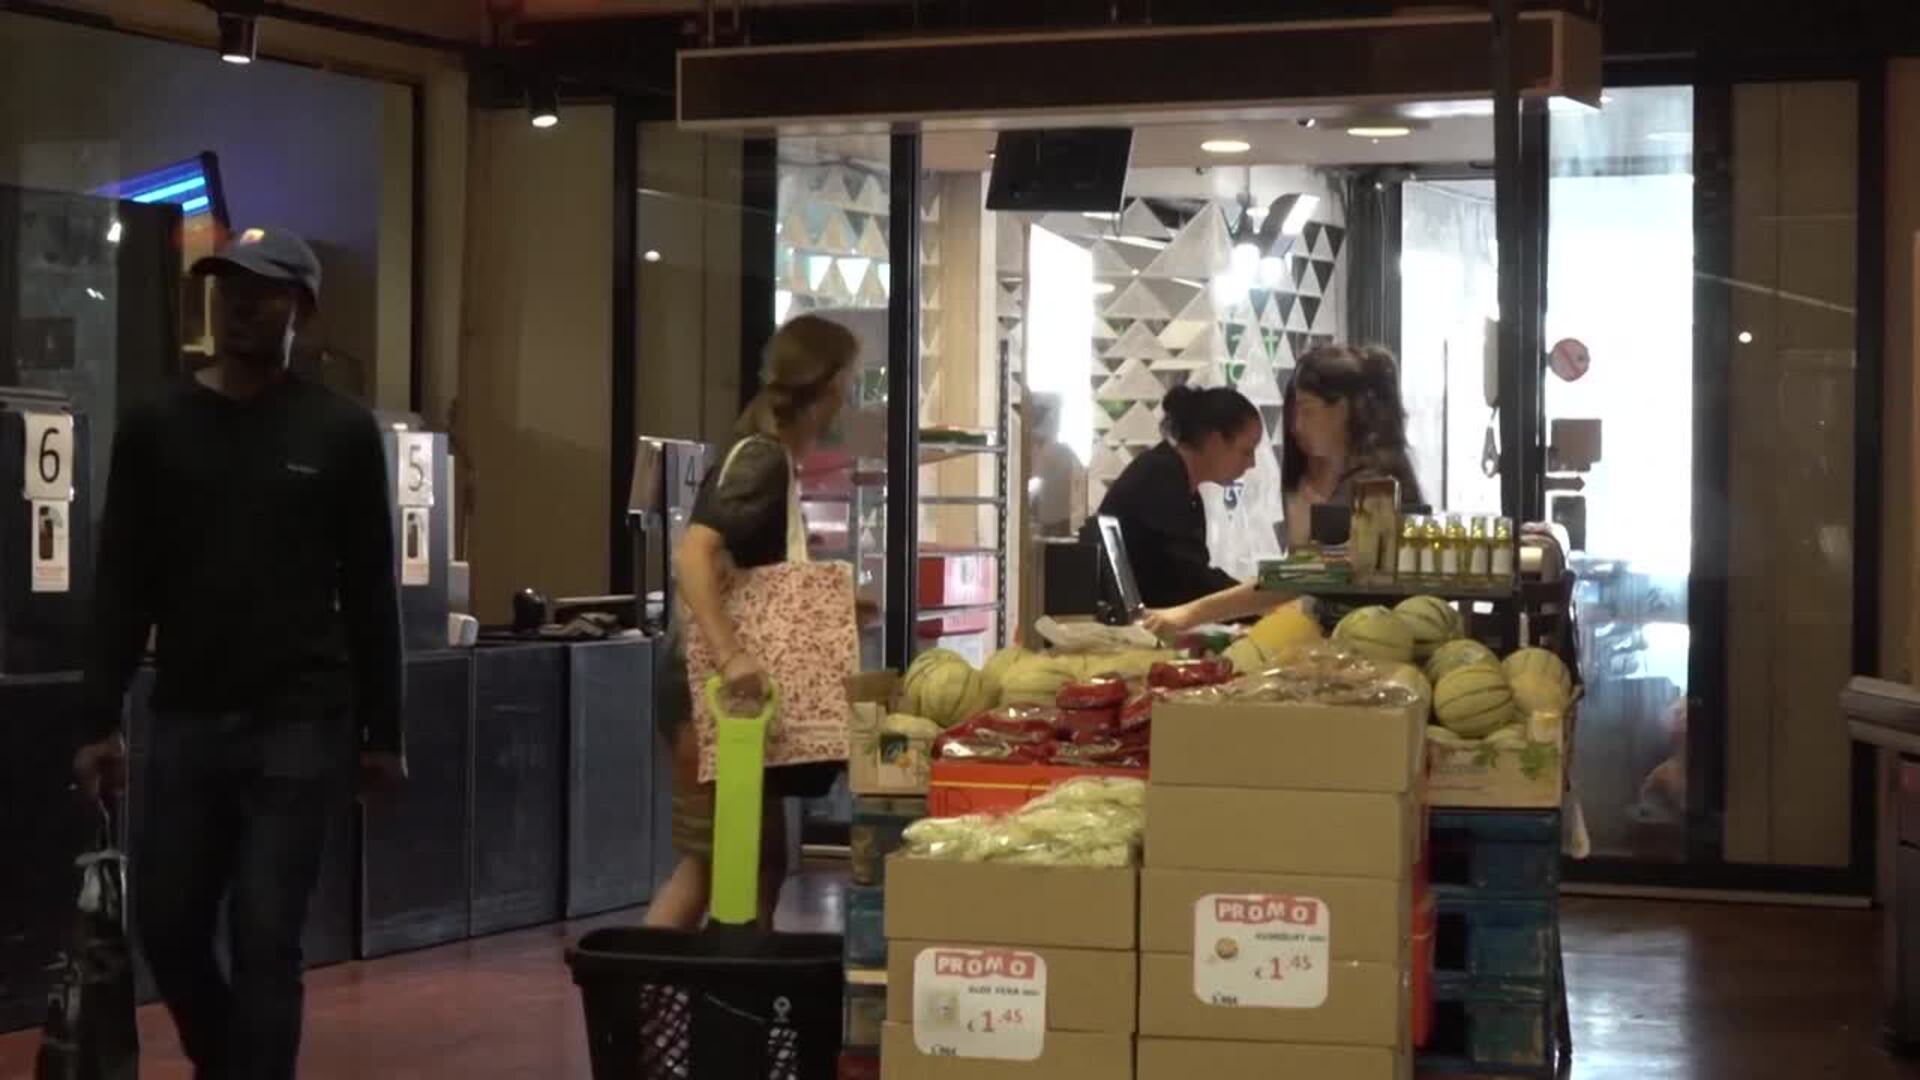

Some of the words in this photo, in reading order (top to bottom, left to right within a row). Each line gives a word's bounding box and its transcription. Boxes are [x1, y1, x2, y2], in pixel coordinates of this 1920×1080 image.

[38, 427, 61, 484] 6
[407, 444, 425, 493] 5
[684, 455, 697, 493] 4
[1217, 900, 1309, 922] PROMO
[936, 955, 1027, 977] PROMO
